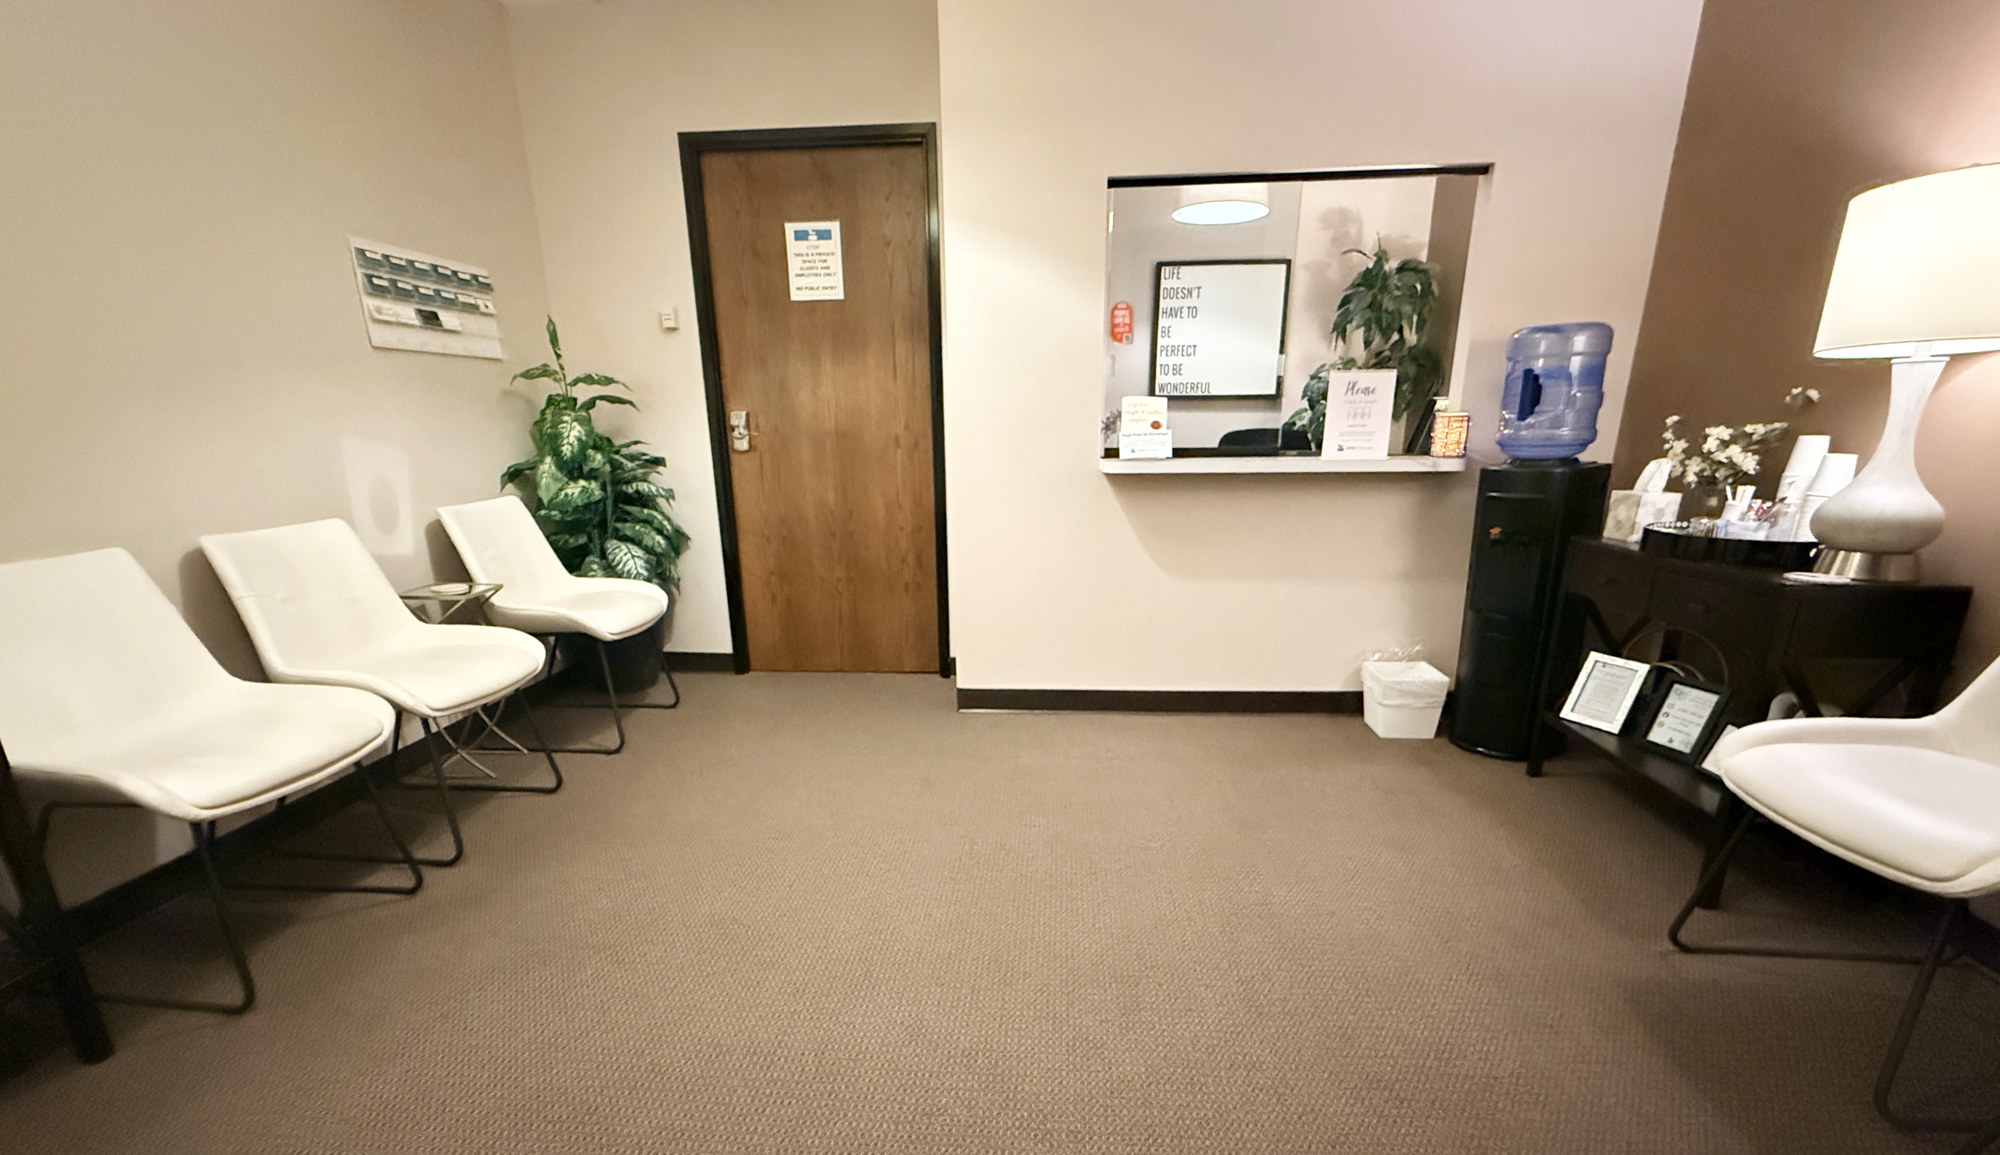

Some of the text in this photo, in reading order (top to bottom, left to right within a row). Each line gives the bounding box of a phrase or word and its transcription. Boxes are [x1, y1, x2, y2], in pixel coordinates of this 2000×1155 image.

[1163, 266, 1181, 280] LIFE
[1162, 286, 1202, 300] DOESN'T
[1161, 305, 1198, 319] HAVE TO
[1160, 325, 1172, 338] BE
[1159, 344, 1197, 357] PERFECT
[1159, 363, 1183, 376] TO BE
[1158, 381, 1211, 394] WONDERFUL
[1344, 380, 1377, 396] Please
